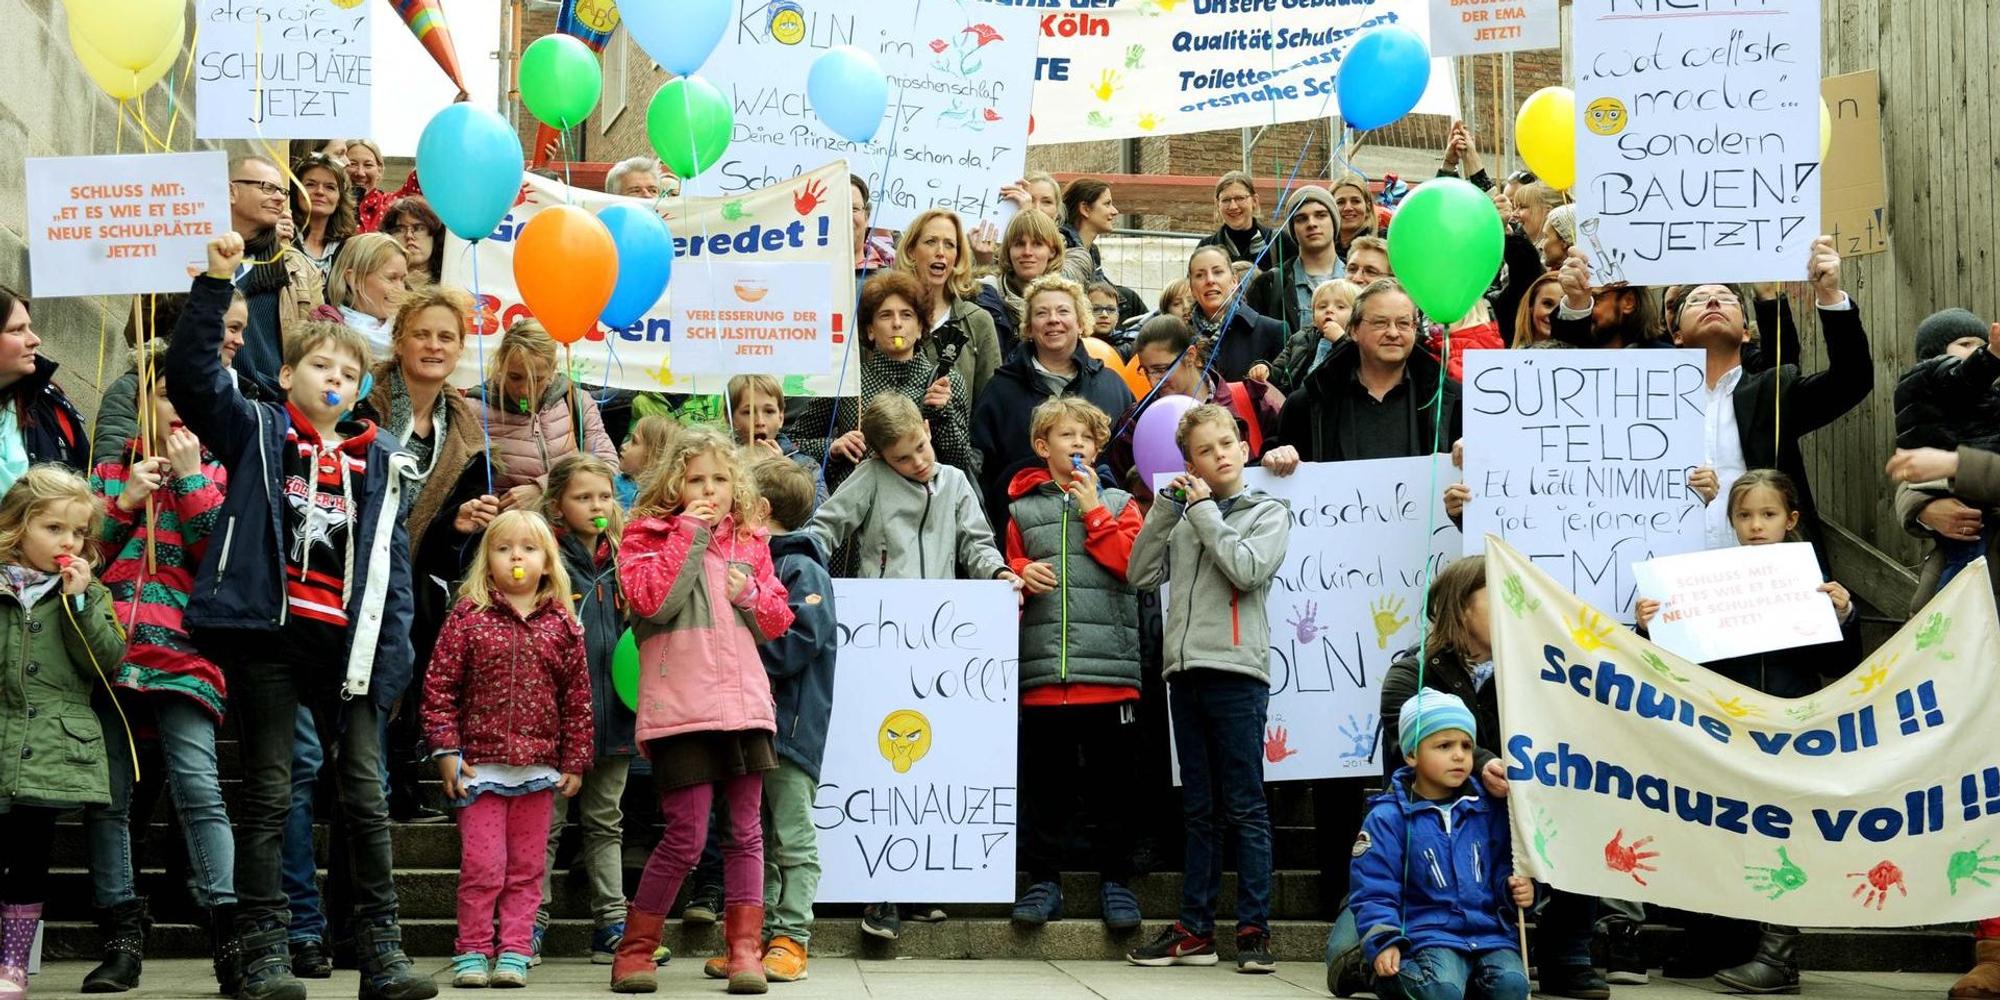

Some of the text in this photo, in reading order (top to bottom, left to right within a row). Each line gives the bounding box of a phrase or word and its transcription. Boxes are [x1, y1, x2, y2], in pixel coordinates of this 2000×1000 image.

[1041, 13, 1110, 37] Köln
[1462, 8, 1525, 22] DER EMA
[880, 29, 914, 58] im
[1172, 29, 1273, 52] Qualität
[248, 88, 349, 123] JETZT
[1180, 84, 1298, 112] ortsnahe
[731, 123, 785, 146] Deine
[790, 125, 857, 153] Prinzen
[904, 145, 953, 165] schon
[1618, 124, 1784, 160] sondern
[70, 183, 186, 199] SCHLUSS MIT:
[1591, 163, 1819, 215] BAUEN!
[86, 205, 103, 219] ES
[111, 204, 142, 218] WIE
[149, 204, 166, 217] ET
[48, 221, 213, 241] NEUE SCHULPLÄTZE
[673, 220, 805, 257] eredet
[107, 244, 156, 258] JETZT!
[793, 311, 817, 322] DER
[735, 345, 773, 355] JETZT!
[1473, 360, 1704, 419] SÜRTHER
[1522, 423, 1668, 462] FELD
[1677, 571, 1739, 588] SCHLUSS
[1688, 590, 1708, 602] ES
[1716, 586, 1743, 598] WIE
[1750, 583, 1765, 593] ET
[1663, 604, 1701, 624] NEUE
[1749, 705, 1877, 756] voll
[1506, 734, 1793, 839] Schnauze
[1812, 784, 1943, 842] voll
[813, 783, 1016, 829] SCHNAUZE
[855, 831, 1009, 878] VOLL!
